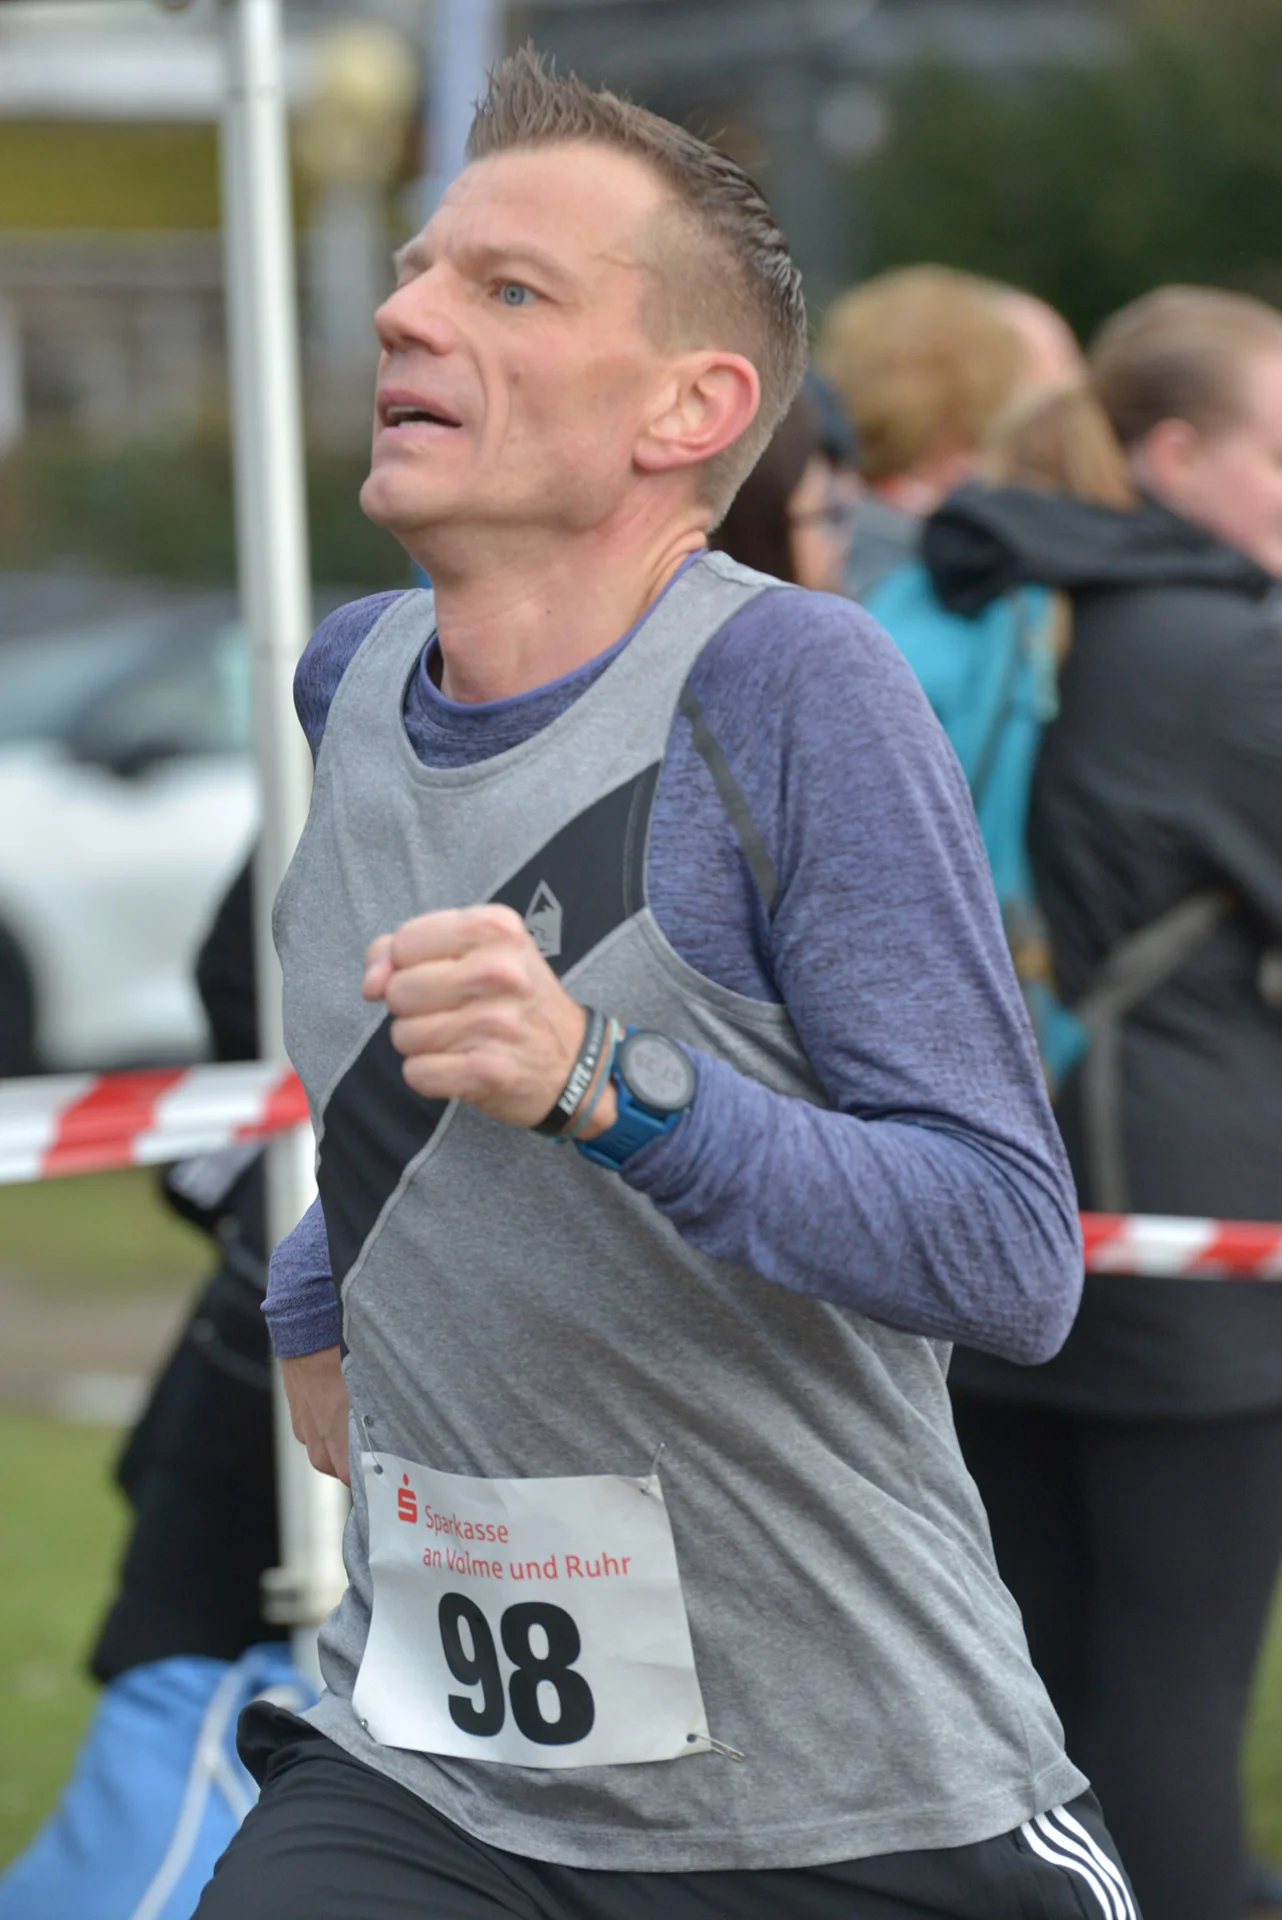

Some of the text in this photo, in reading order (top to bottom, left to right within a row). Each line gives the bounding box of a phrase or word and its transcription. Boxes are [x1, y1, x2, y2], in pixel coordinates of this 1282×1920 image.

[424, 1505, 509, 1543] Sparkasse
[422, 1546, 632, 1580] an Volme und Ruhr
[438, 1592, 595, 1746] 98
